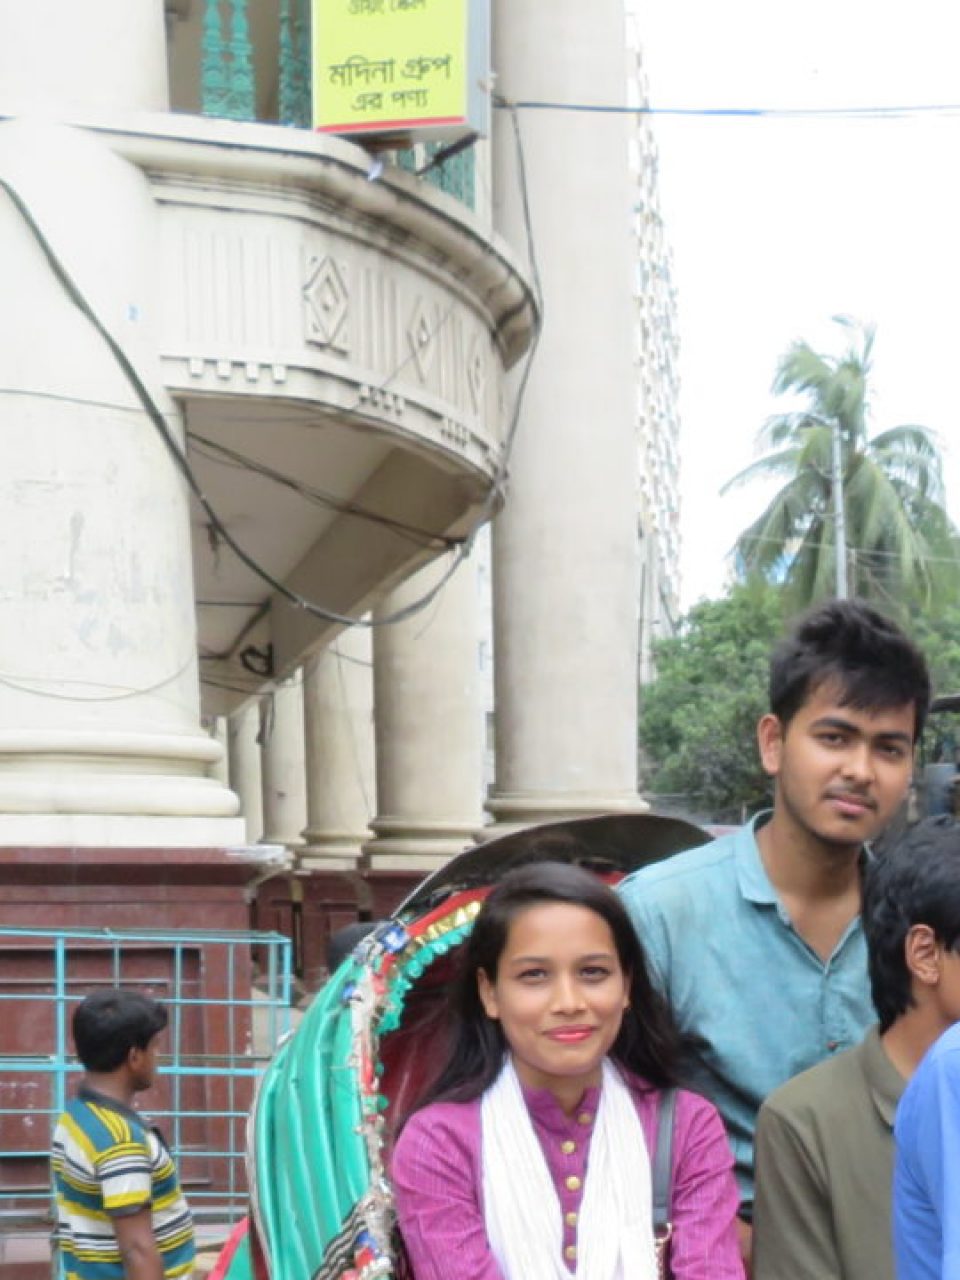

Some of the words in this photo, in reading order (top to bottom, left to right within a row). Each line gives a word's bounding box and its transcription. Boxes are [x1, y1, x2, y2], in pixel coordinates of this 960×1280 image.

[328, 54, 396, 87] মদিনা
[400, 53, 452, 81] গ্রুপ
[350, 91, 384, 111] এর
[390, 88, 428, 108] পণ্য
